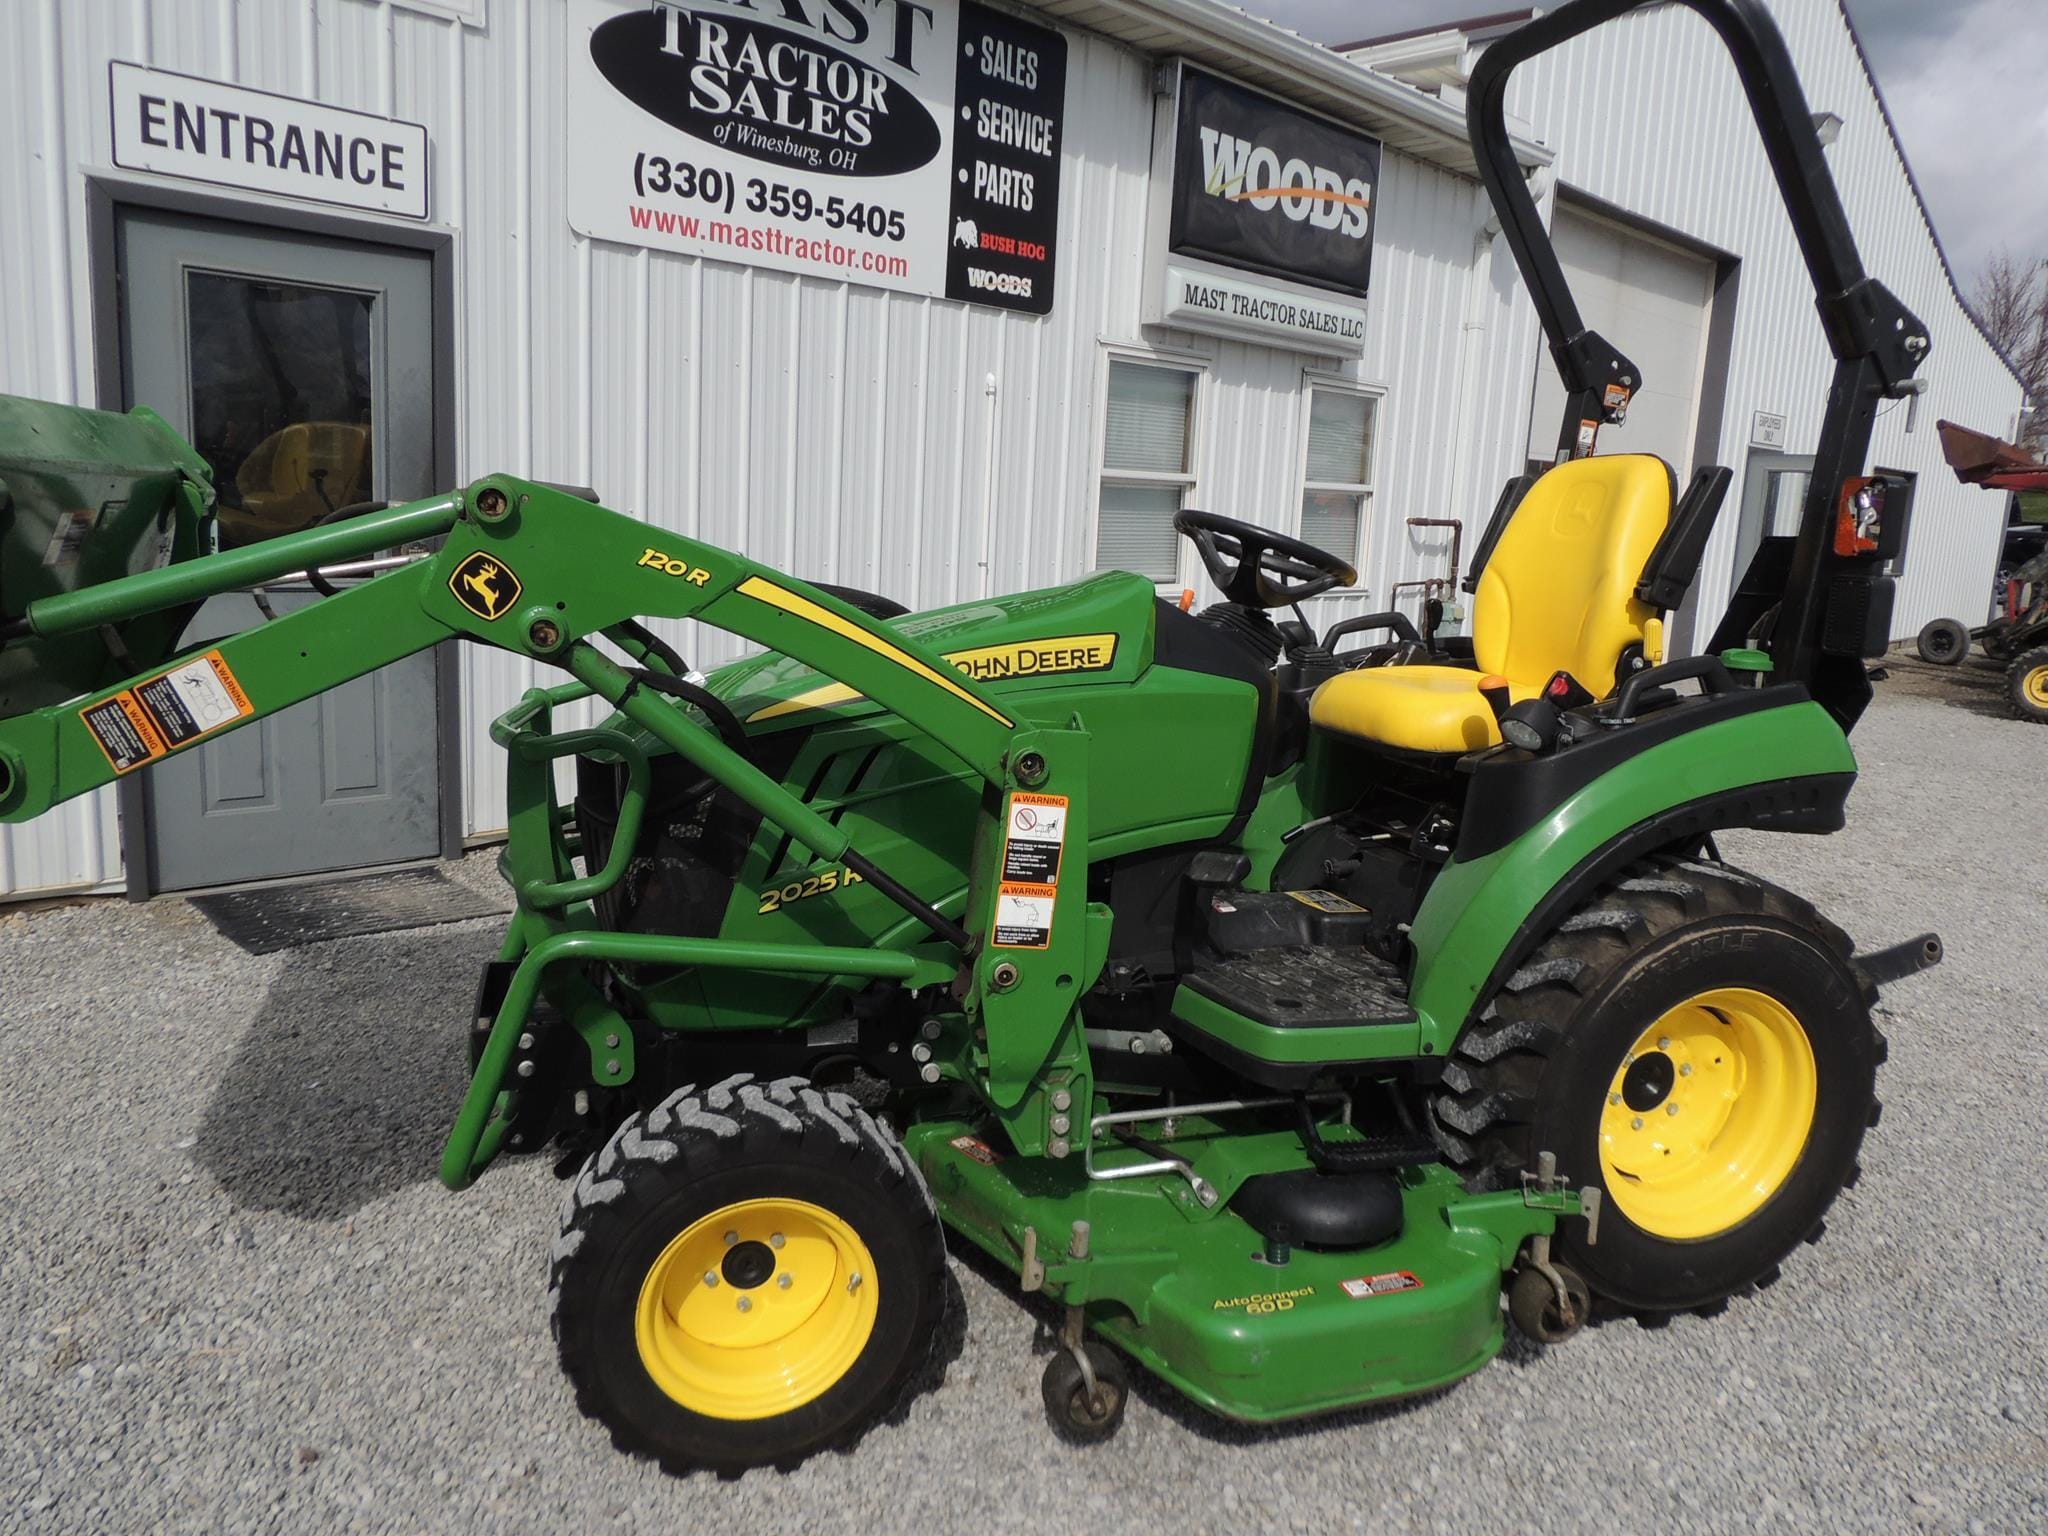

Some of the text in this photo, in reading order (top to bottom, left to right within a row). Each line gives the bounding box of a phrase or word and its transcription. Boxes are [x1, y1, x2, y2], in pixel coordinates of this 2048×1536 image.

[651, 2, 889, 115] TRACTOR
[980, 34, 1039, 91] SALES
[689, 64, 873, 147] SALES
[977, 97, 1054, 157] SERVICE
[138, 93, 406, 192] ENTRANCE
[712, 121, 859, 171] of Winesburg, OH
[633, 152, 907, 243] (330) 359-5405
[973, 159, 1035, 212] PARTS
[1200, 126, 1371, 240] WOODS
[628, 204, 909, 278] www.masttractor.com
[980, 232, 1046, 261] BUSH HOG
[967, 266, 1032, 298] WOODS
[1184, 283, 1363, 339] MAST TRACTOR SALES LLC
[218, 668, 247, 708] WARNING
[948, 648, 1101, 678] OHN DEERE
[128, 709, 158, 750] WARNING
[1022, 794, 1066, 807] WARNING
[1010, 886, 1054, 897] WARNING
[1213, 1284, 1315, 1311] AutoConnect
